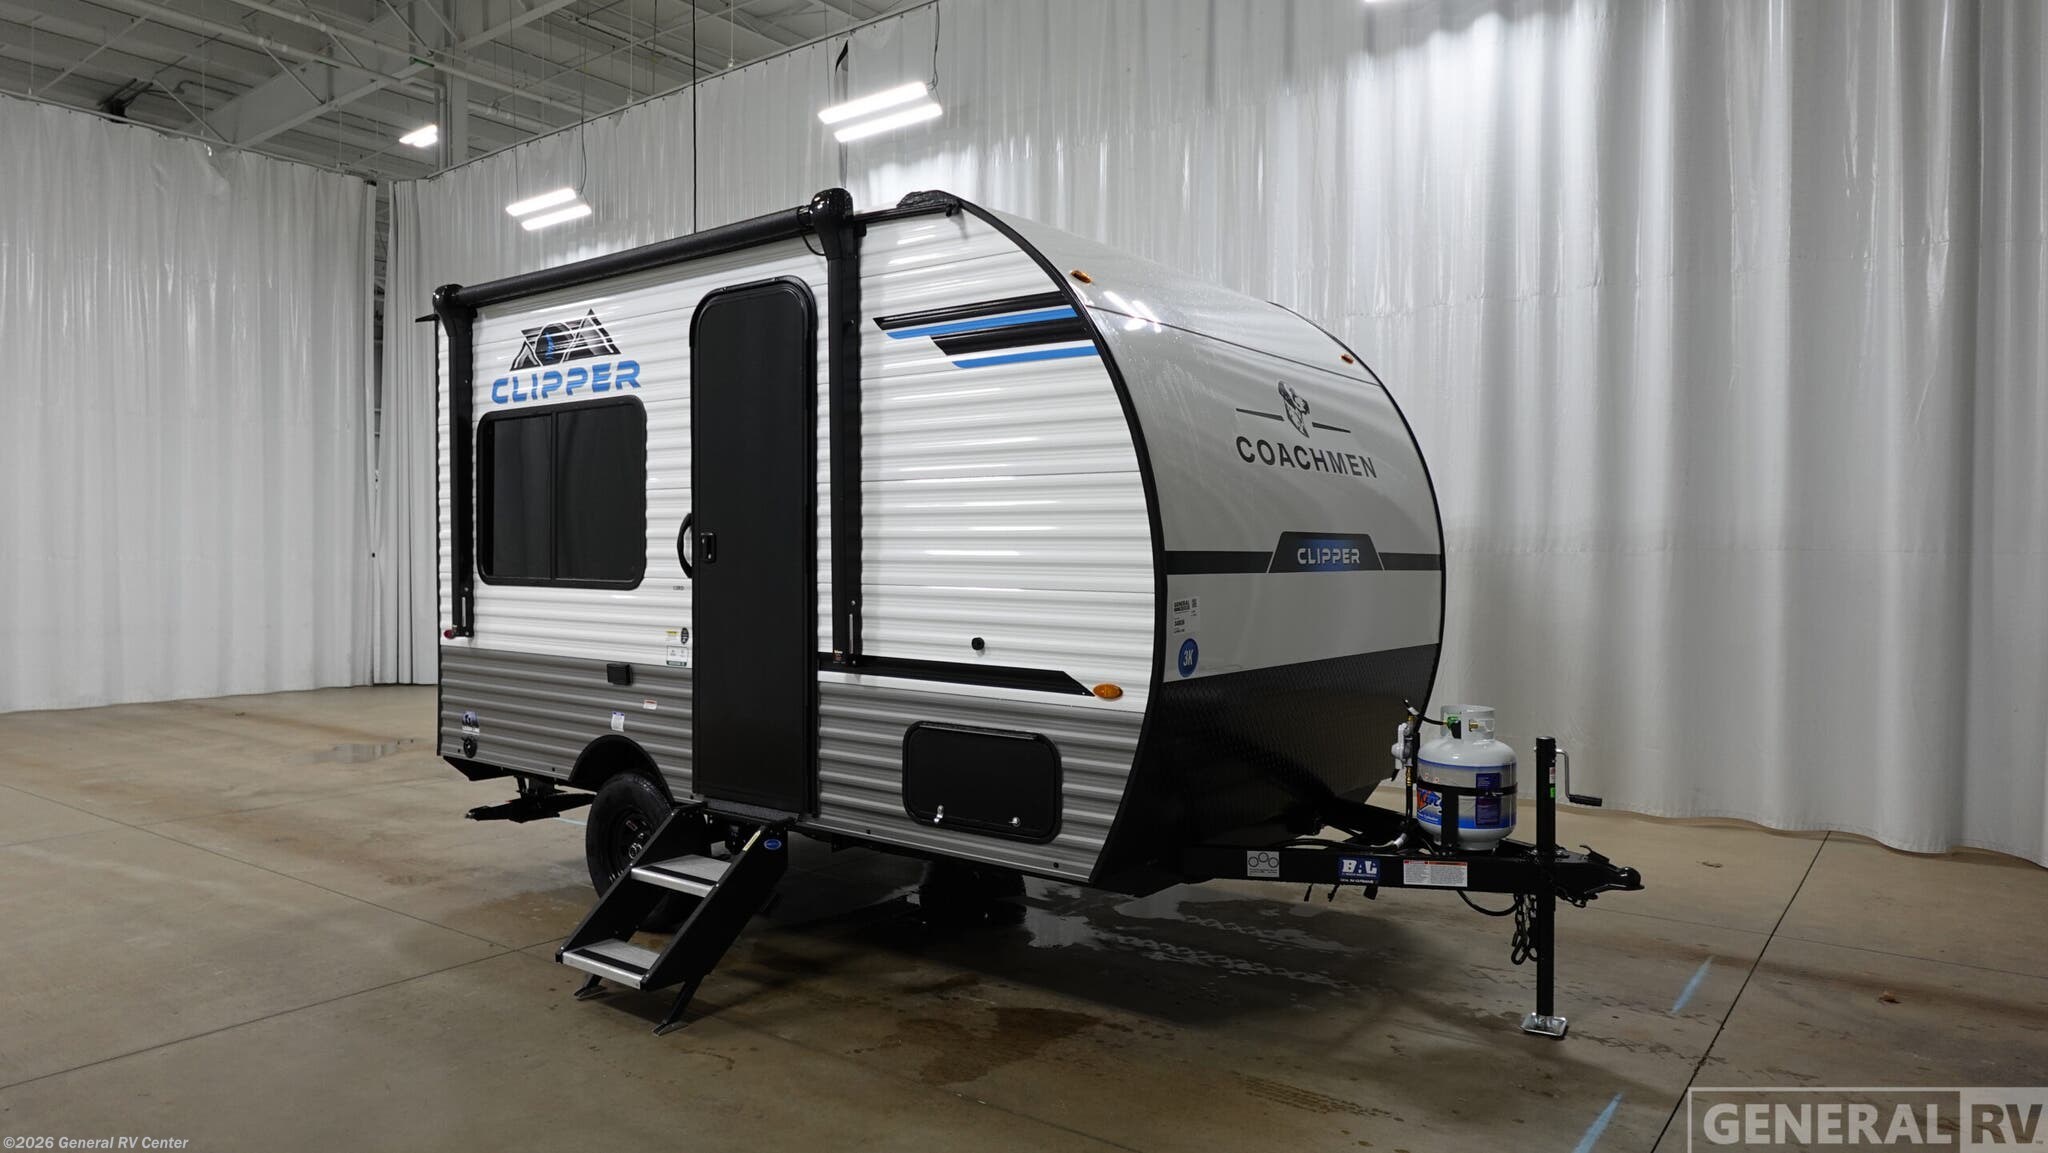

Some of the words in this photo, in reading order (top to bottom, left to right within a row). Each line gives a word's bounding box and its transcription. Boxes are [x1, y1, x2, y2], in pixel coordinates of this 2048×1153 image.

[491, 359, 641, 405] CLIPPER
[1235, 435, 1378, 479] COACHMEN
[1297, 548, 1360, 565] CLIPPER
